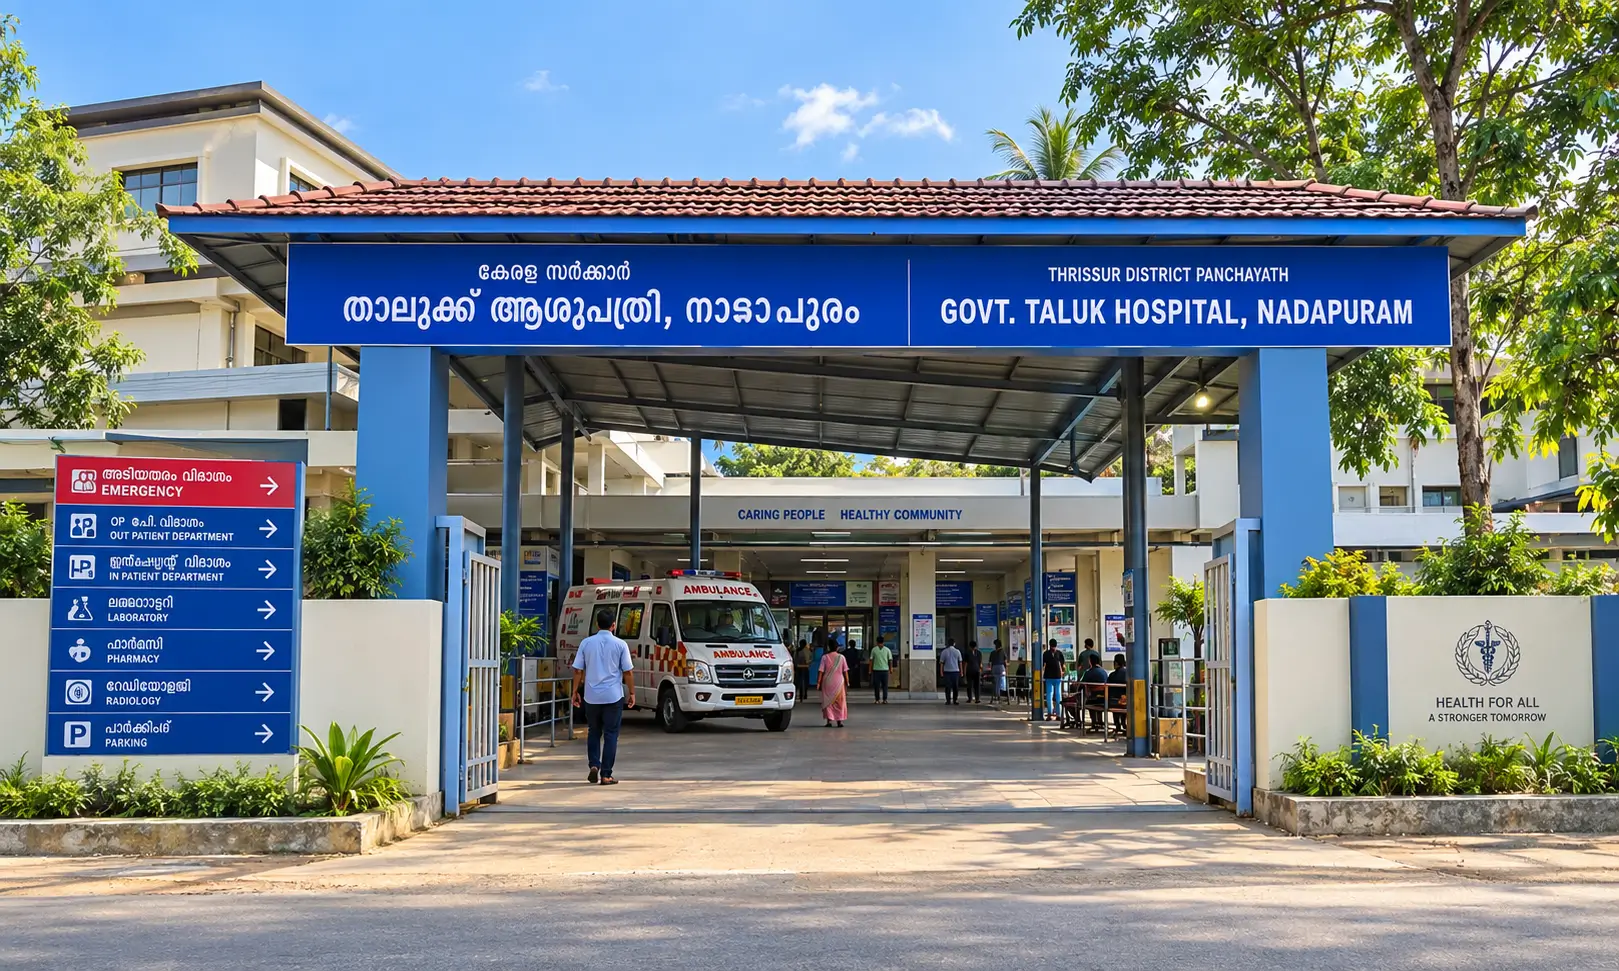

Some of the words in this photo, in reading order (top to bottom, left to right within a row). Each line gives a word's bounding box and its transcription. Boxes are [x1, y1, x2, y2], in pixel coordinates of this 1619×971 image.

[478, 264, 538, 284] കേരള
[546, 260, 631, 281] സർക്കാർ
[1048, 266, 1121, 282] THRISSUR
[1126, 266, 1192, 282] DISTRICT
[1196, 266, 1289, 282] PANCHAYATH
[490, 288, 672, 331] ആശുപത്രി,
[940, 298, 1015, 325] GOVT.
[1025, 298, 1106, 325] TALUK
[1115, 298, 1247, 330] HOSPITAL,
[1257, 299, 1413, 325] NADAPURAM
[101, 484, 184, 497] EMERGENCY
[737, 508, 780, 522] CARING
[784, 508, 826, 521] PEOPLE
[840, 508, 891, 521] HEALTHY
[893, 508, 963, 521] COMMUNITY
[109, 530, 130, 541] OUT
[131, 531, 171, 542] PATIENT
[172, 532, 234, 542] DEPARTMENT
[109, 571, 119, 581] IN
[121, 572, 161, 582] PATIENT
[162, 572, 224, 582] DEPARTMENT
[683, 585, 752, 597] AMBULANCE
[107, 612, 169, 623] LABORATORY
[107, 654, 160, 664] PHARMACY
[713, 650, 776, 660] AMBULANCE
[106, 696, 162, 706] RADIOLOGY
[1436, 696, 1485, 709] HEALTH
[1488, 696, 1514, 709] FOR
[1516, 696, 1540, 709] ALL
[1428, 713, 1436, 722] A
[1438, 713, 1488, 722] STRONGER
[1490, 713, 1547, 722] TOMORROW
[105, 737, 148, 748] PARKING
